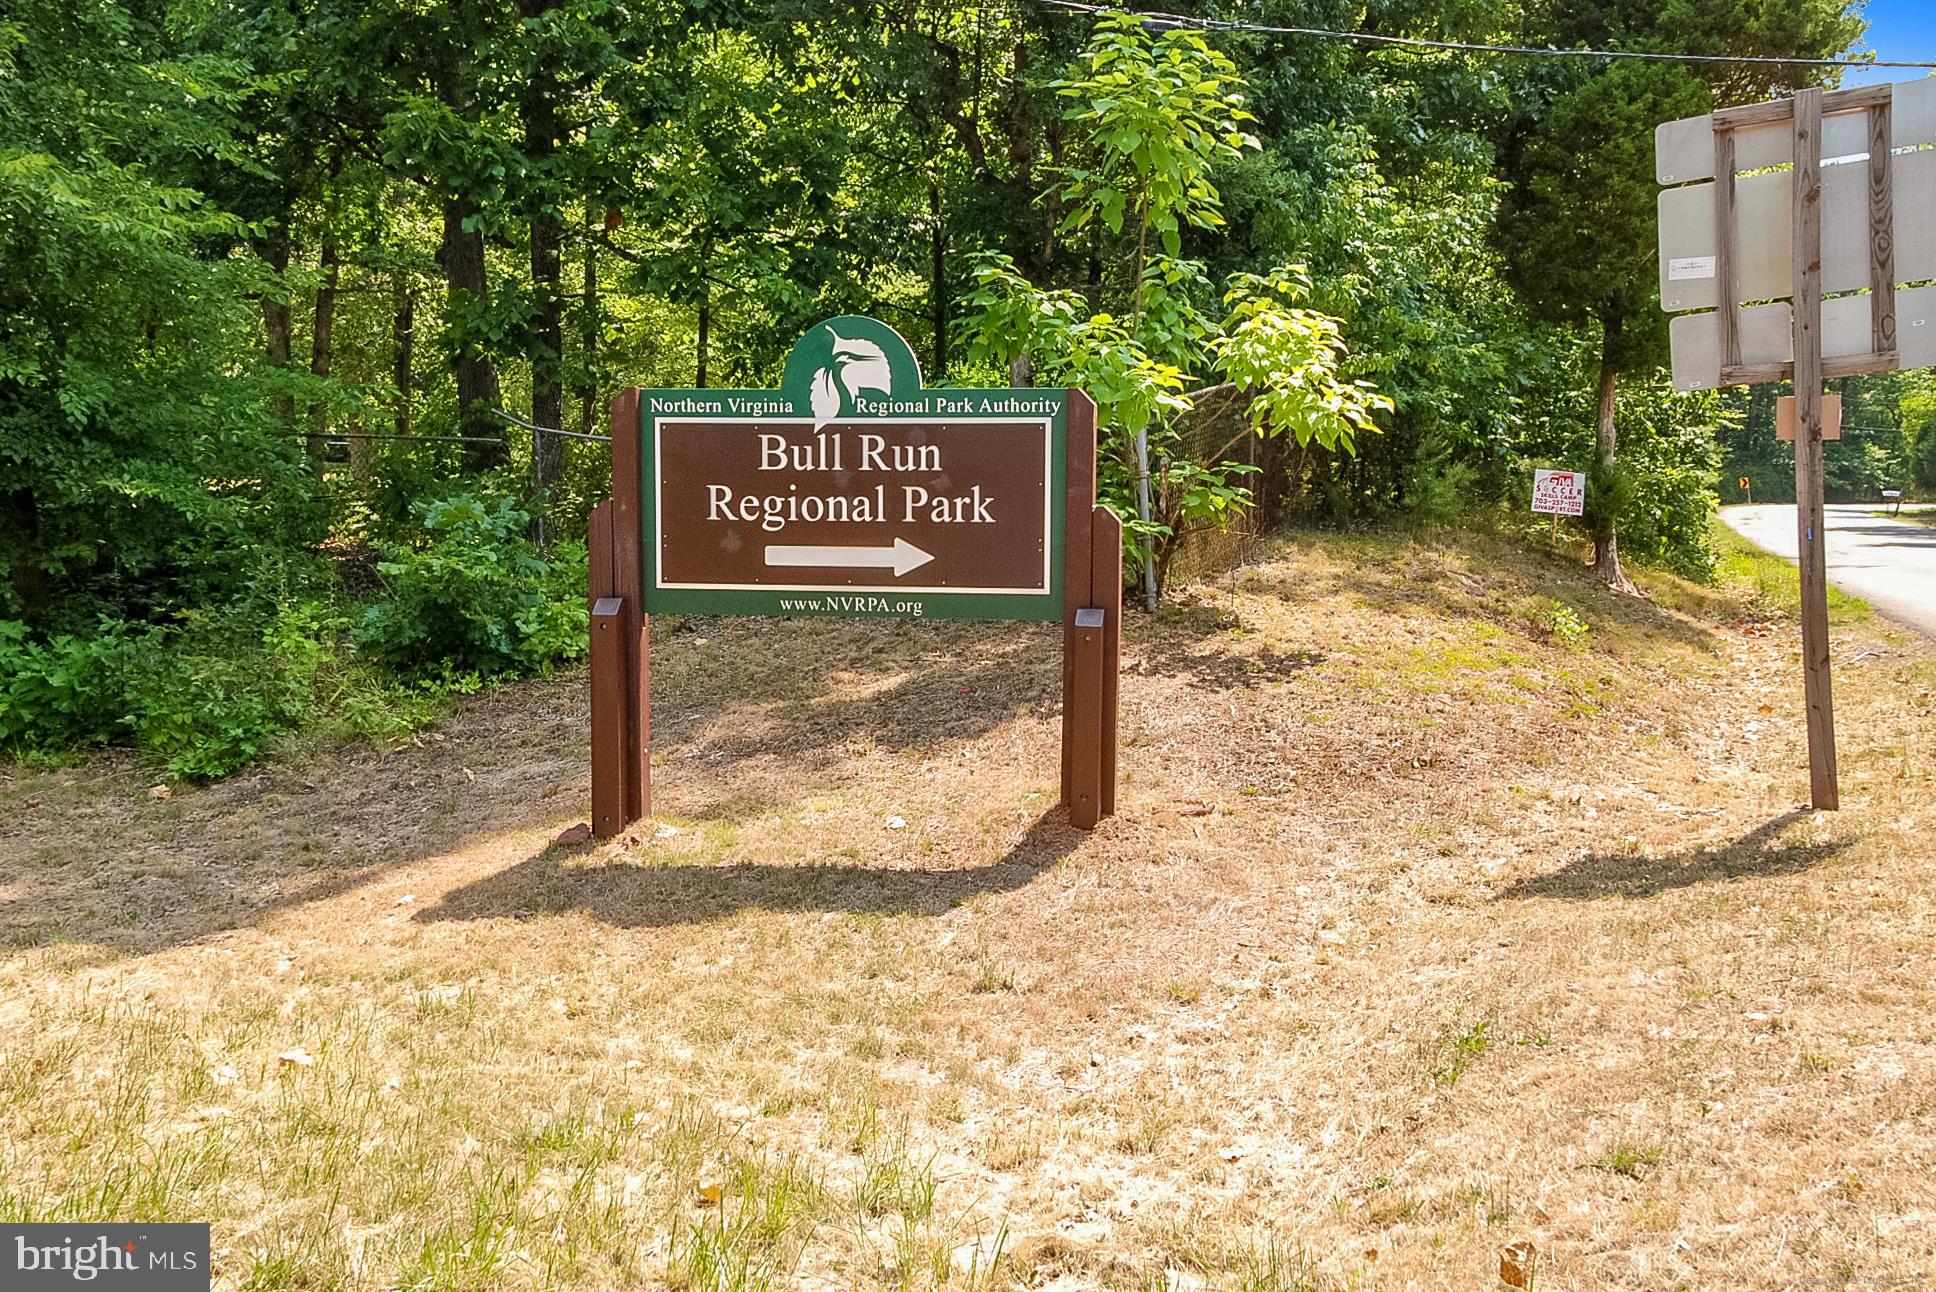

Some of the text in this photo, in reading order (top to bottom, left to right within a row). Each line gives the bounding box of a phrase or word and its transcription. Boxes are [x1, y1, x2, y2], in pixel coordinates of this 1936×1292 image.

[650, 397, 1062, 417] Northern Virginia Regional Park Authority
[757, 432, 943, 473] Bull Run
[705, 484, 997, 531] Regional Park
[1534, 504, 1581, 513] GIVASPRT.COM
[1535, 498, 1582, 507] 703-257-1212
[779, 596, 923, 617] www.NVRPA.org
